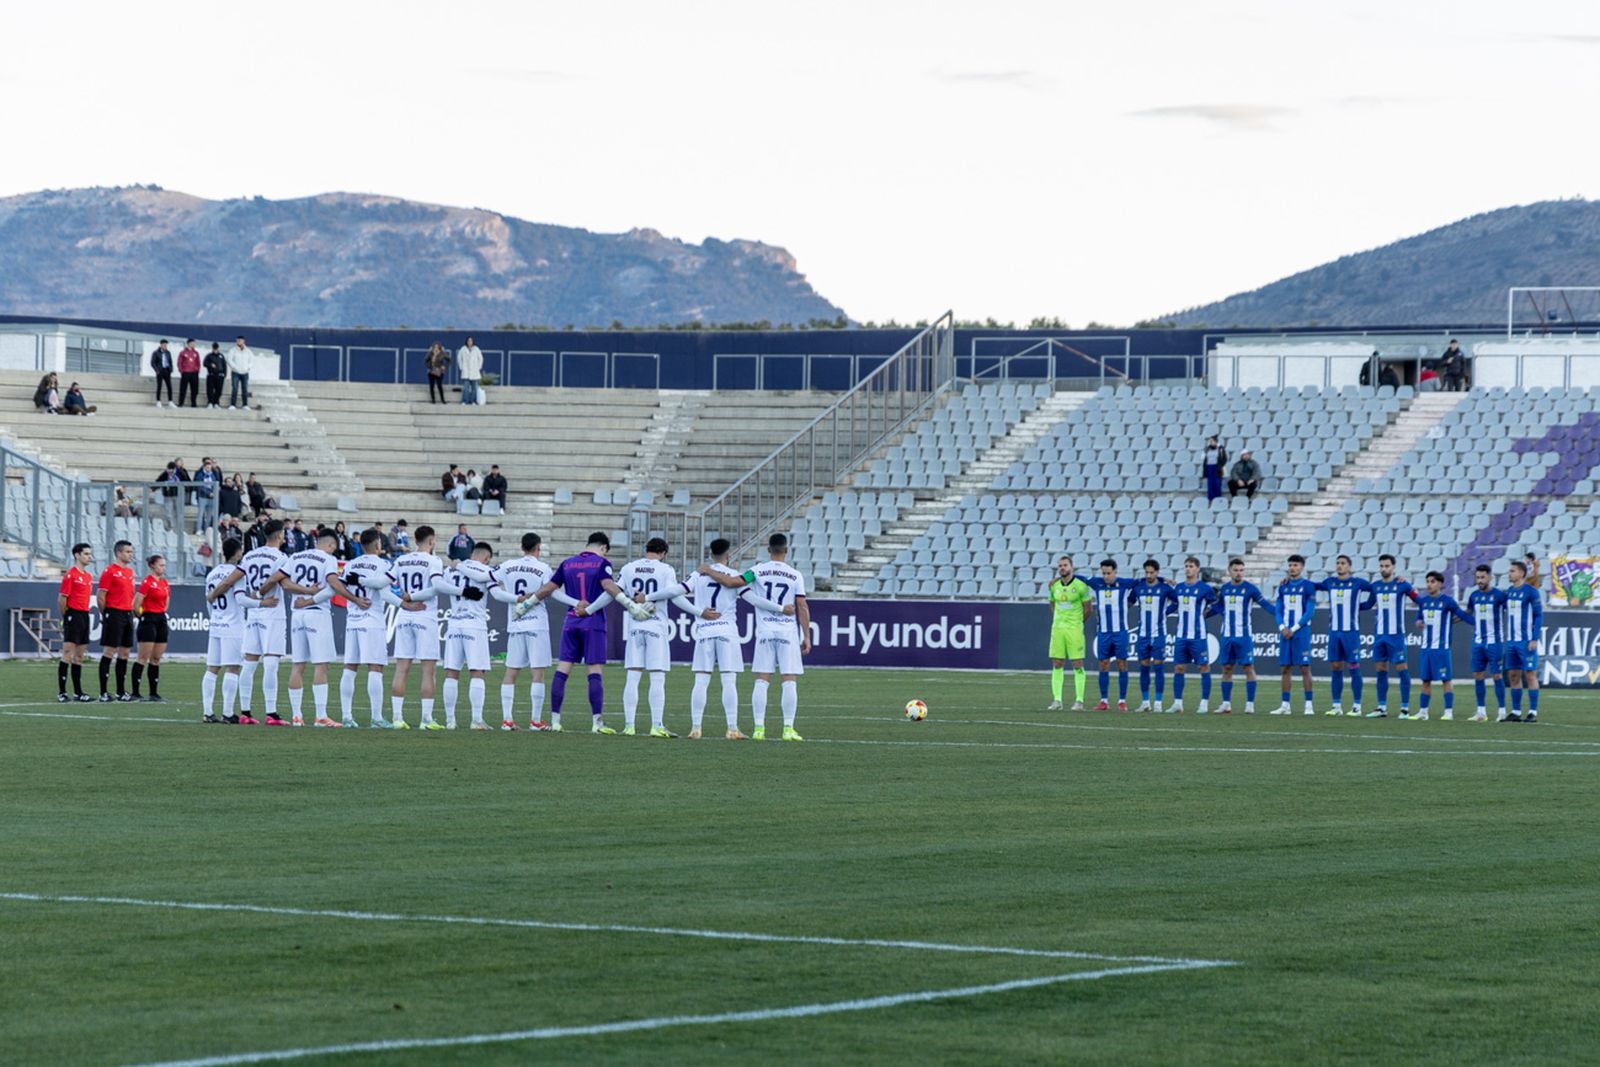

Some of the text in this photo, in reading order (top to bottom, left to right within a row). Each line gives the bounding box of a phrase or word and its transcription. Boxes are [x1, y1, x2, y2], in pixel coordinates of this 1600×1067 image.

[295, 564, 318, 587] 29
[402, 572, 423, 595] 19
[514, 578, 528, 597] 6
[577, 572, 586, 602] 1
[707, 582, 722, 608] 7
[763, 581, 790, 606] 17
[830, 615, 982, 654] Hyundai
